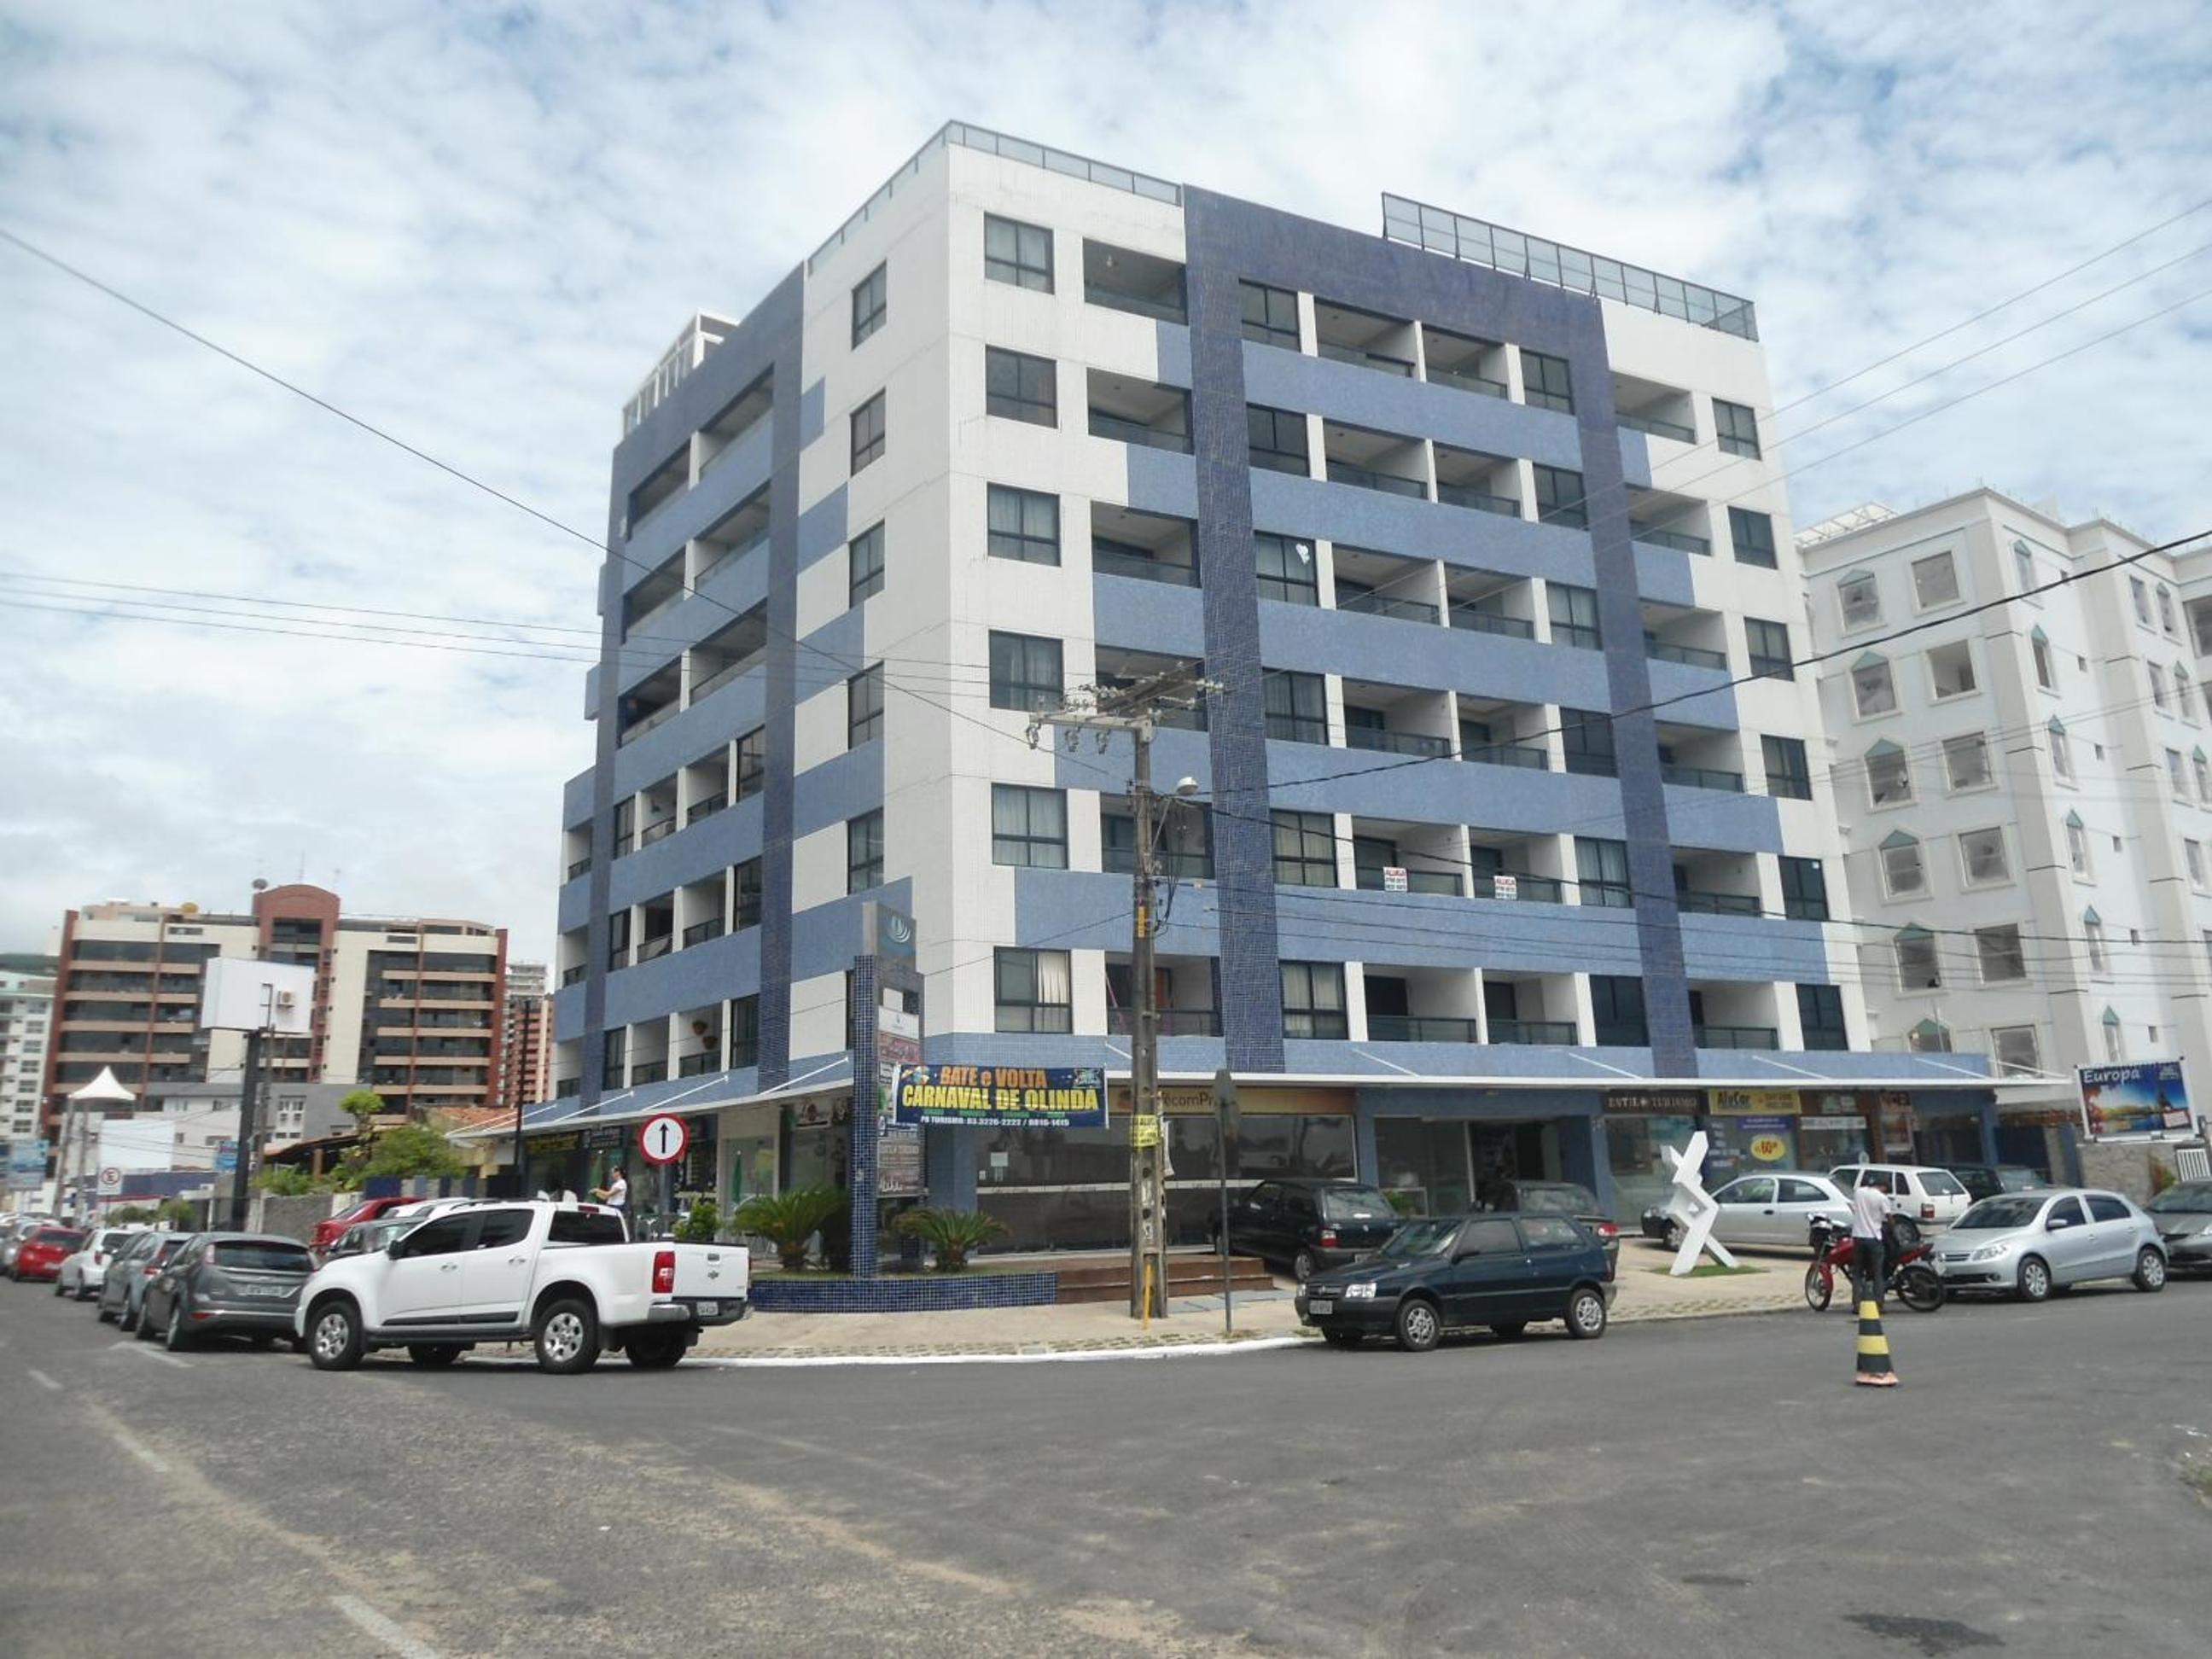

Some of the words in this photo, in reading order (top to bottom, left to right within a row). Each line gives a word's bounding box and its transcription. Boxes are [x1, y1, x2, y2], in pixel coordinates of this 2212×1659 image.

[940, 1066, 978, 1086] BATE
[995, 1068, 1047, 1088] VOLTA
[2083, 1069, 2140, 1086] Europa
[902, 1085, 992, 1109] CARNAVAL
[996, 1088, 1021, 1110] DE
[1024, 1089, 1099, 1110] OLINDA
